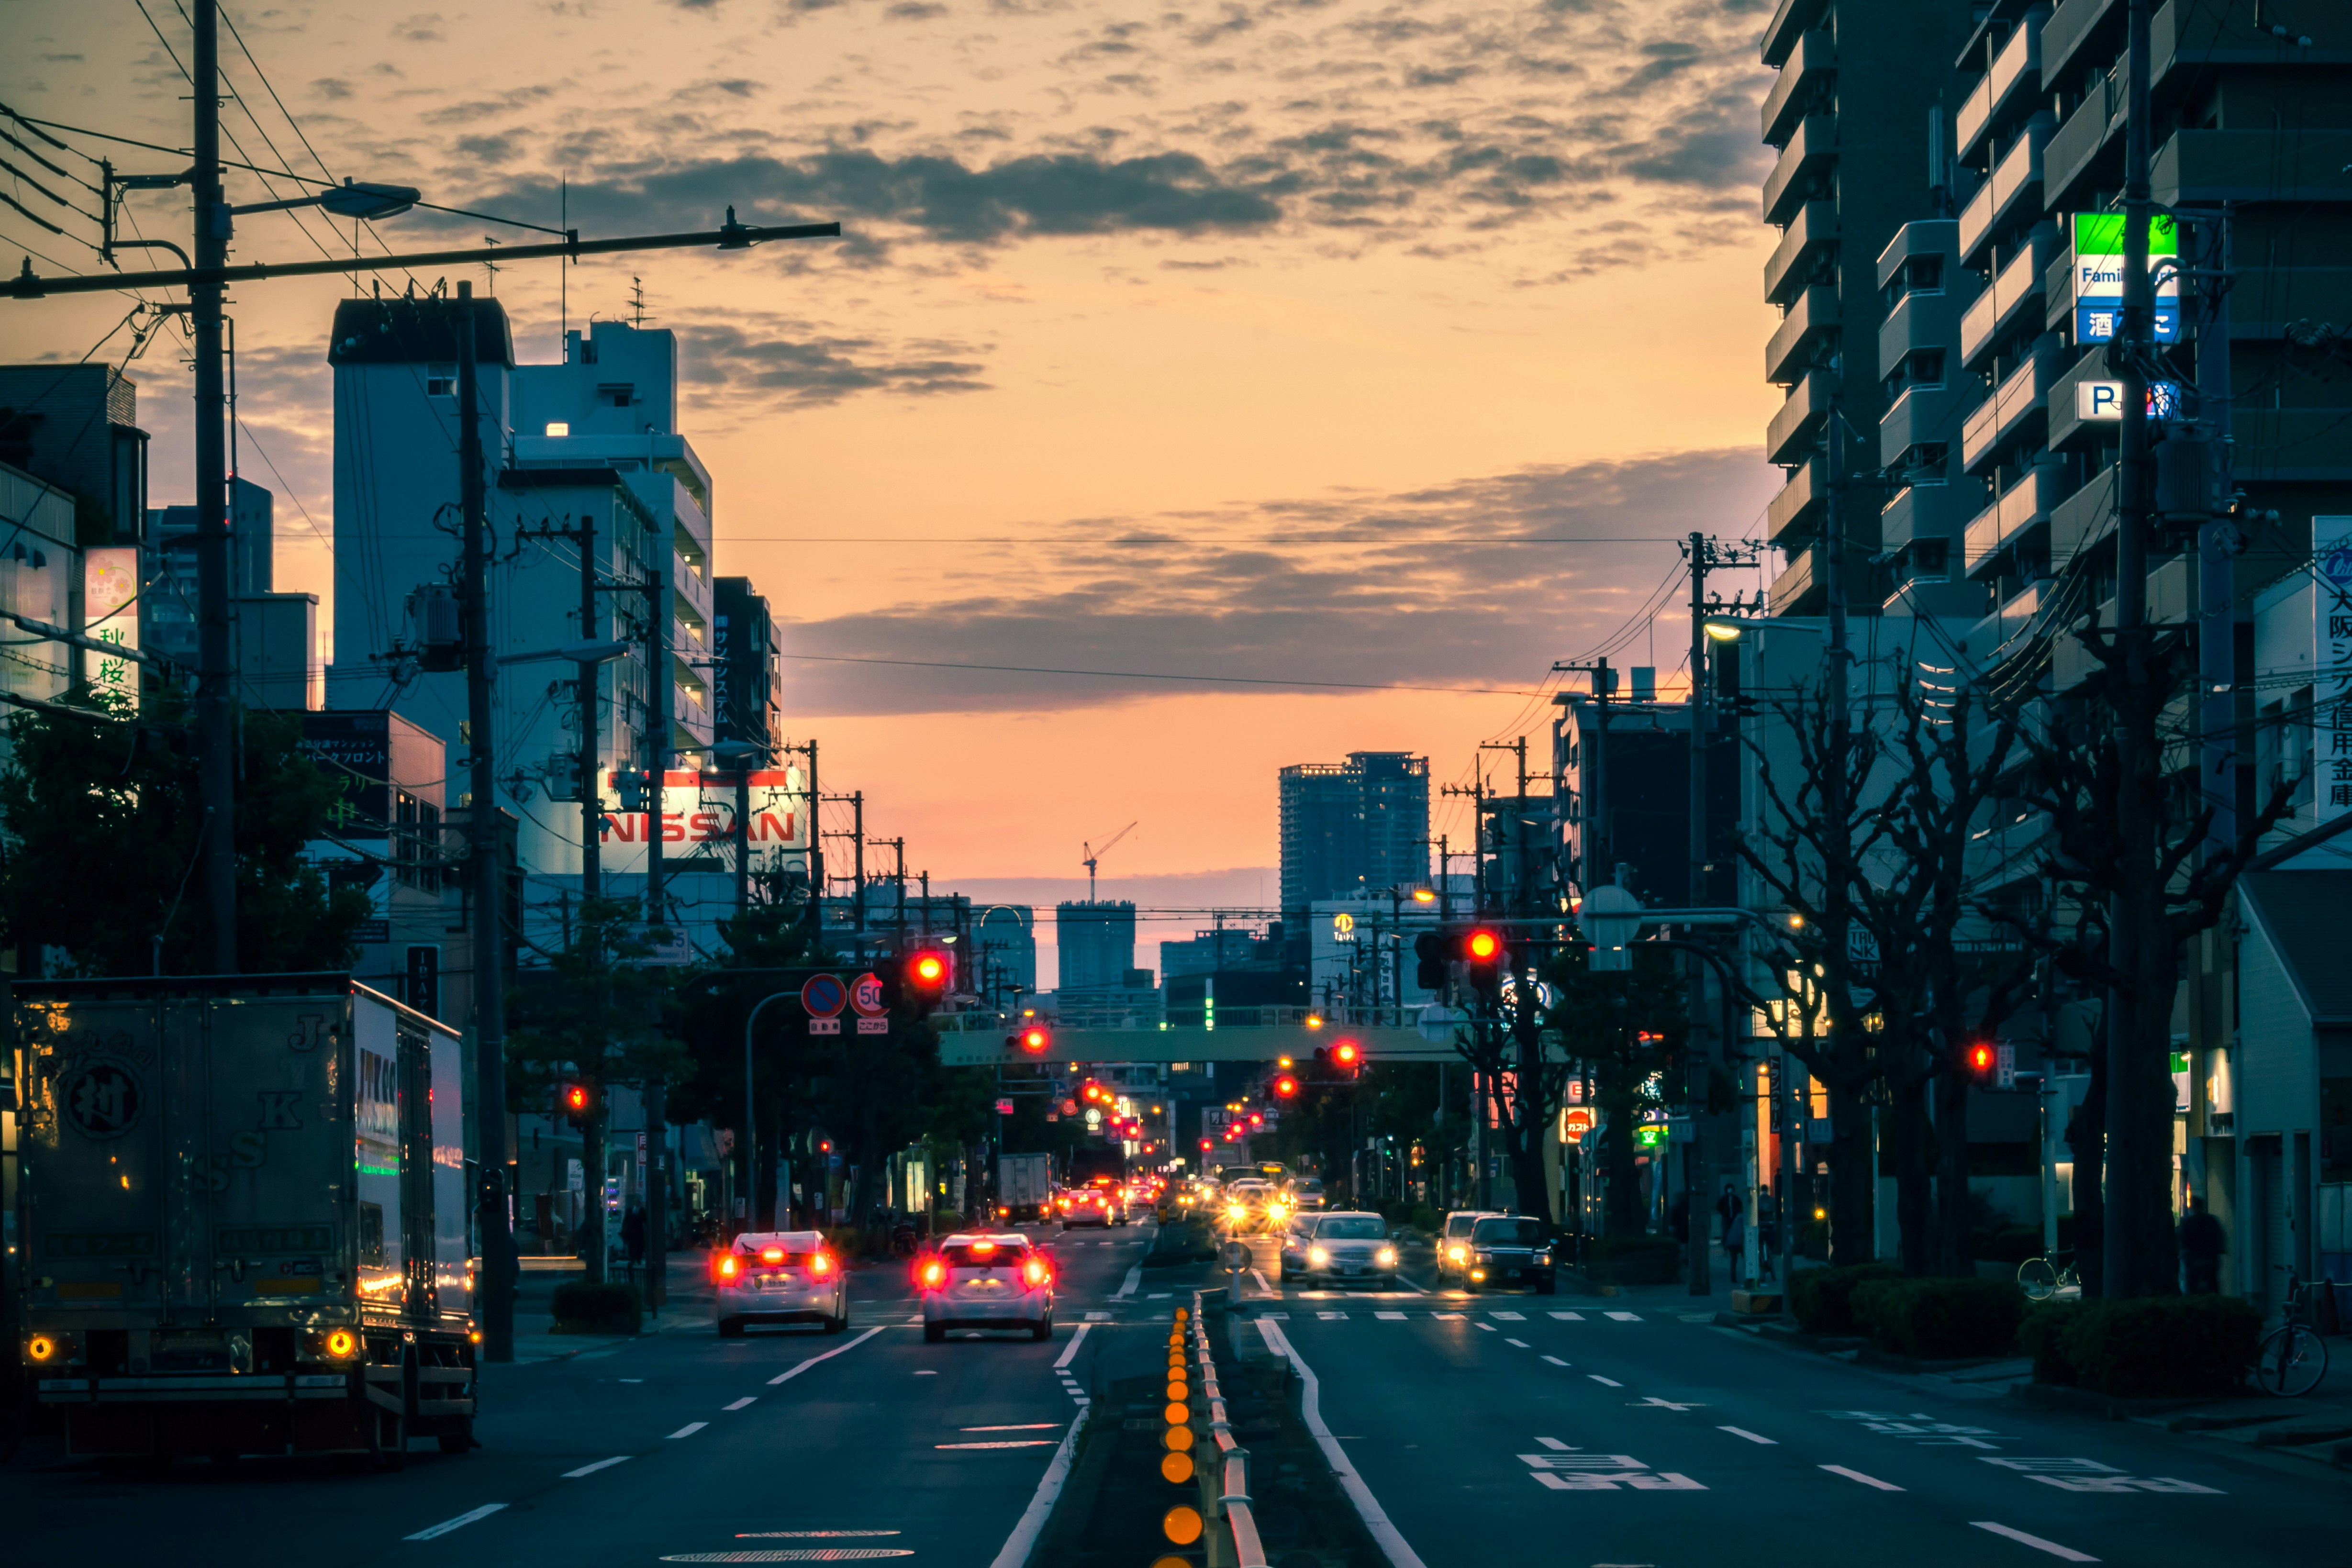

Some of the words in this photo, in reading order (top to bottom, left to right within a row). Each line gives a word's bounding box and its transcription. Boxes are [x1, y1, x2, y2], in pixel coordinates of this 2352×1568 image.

[2083, 267, 2174, 282] Famirt
[2094, 386, 2114, 414] P
[601, 812, 794, 842] NISSAN
[1567, 1123, 1589, 1132] ガスト
